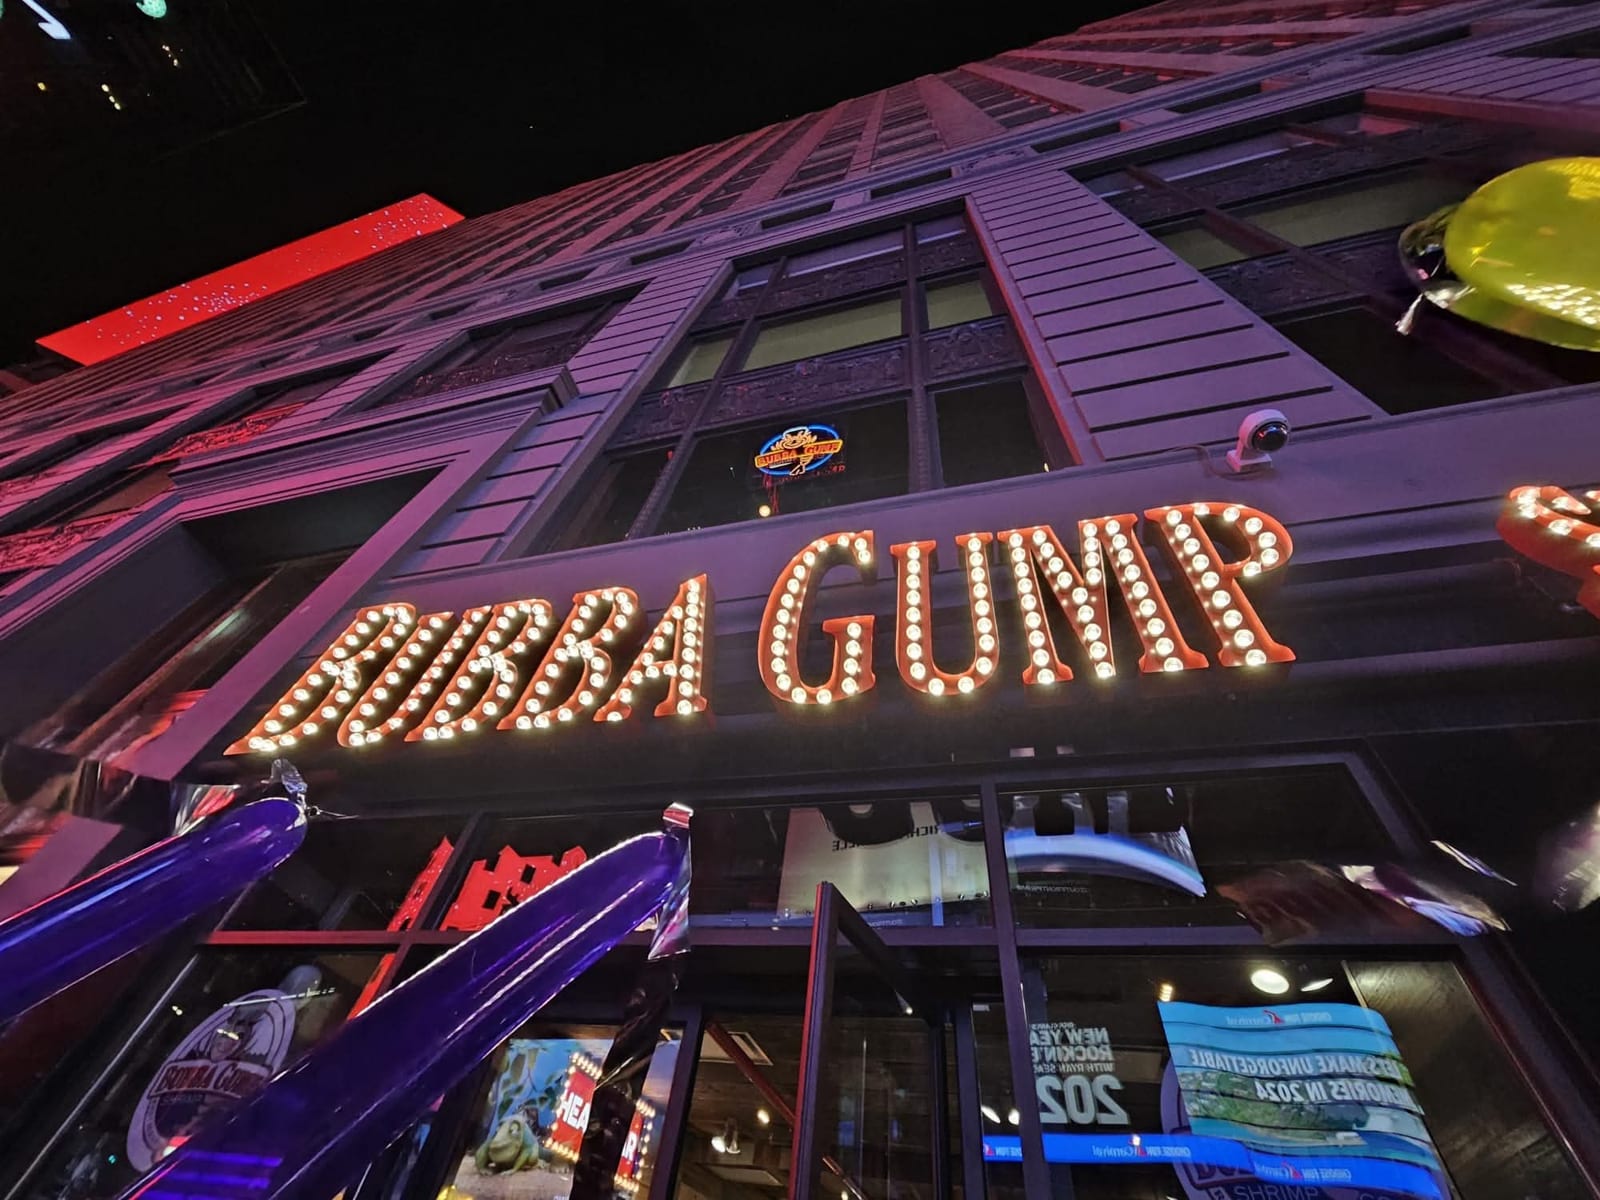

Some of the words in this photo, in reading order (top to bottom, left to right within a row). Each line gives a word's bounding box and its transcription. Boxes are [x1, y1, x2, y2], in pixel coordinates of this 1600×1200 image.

[758, 450, 798, 467] BUBBA
[804, 443, 839, 455] GUMP
[224, 574, 708, 756] BUBBA
[758, 502, 1295, 705] GUMP
[559, 1092, 592, 1134] HEA
